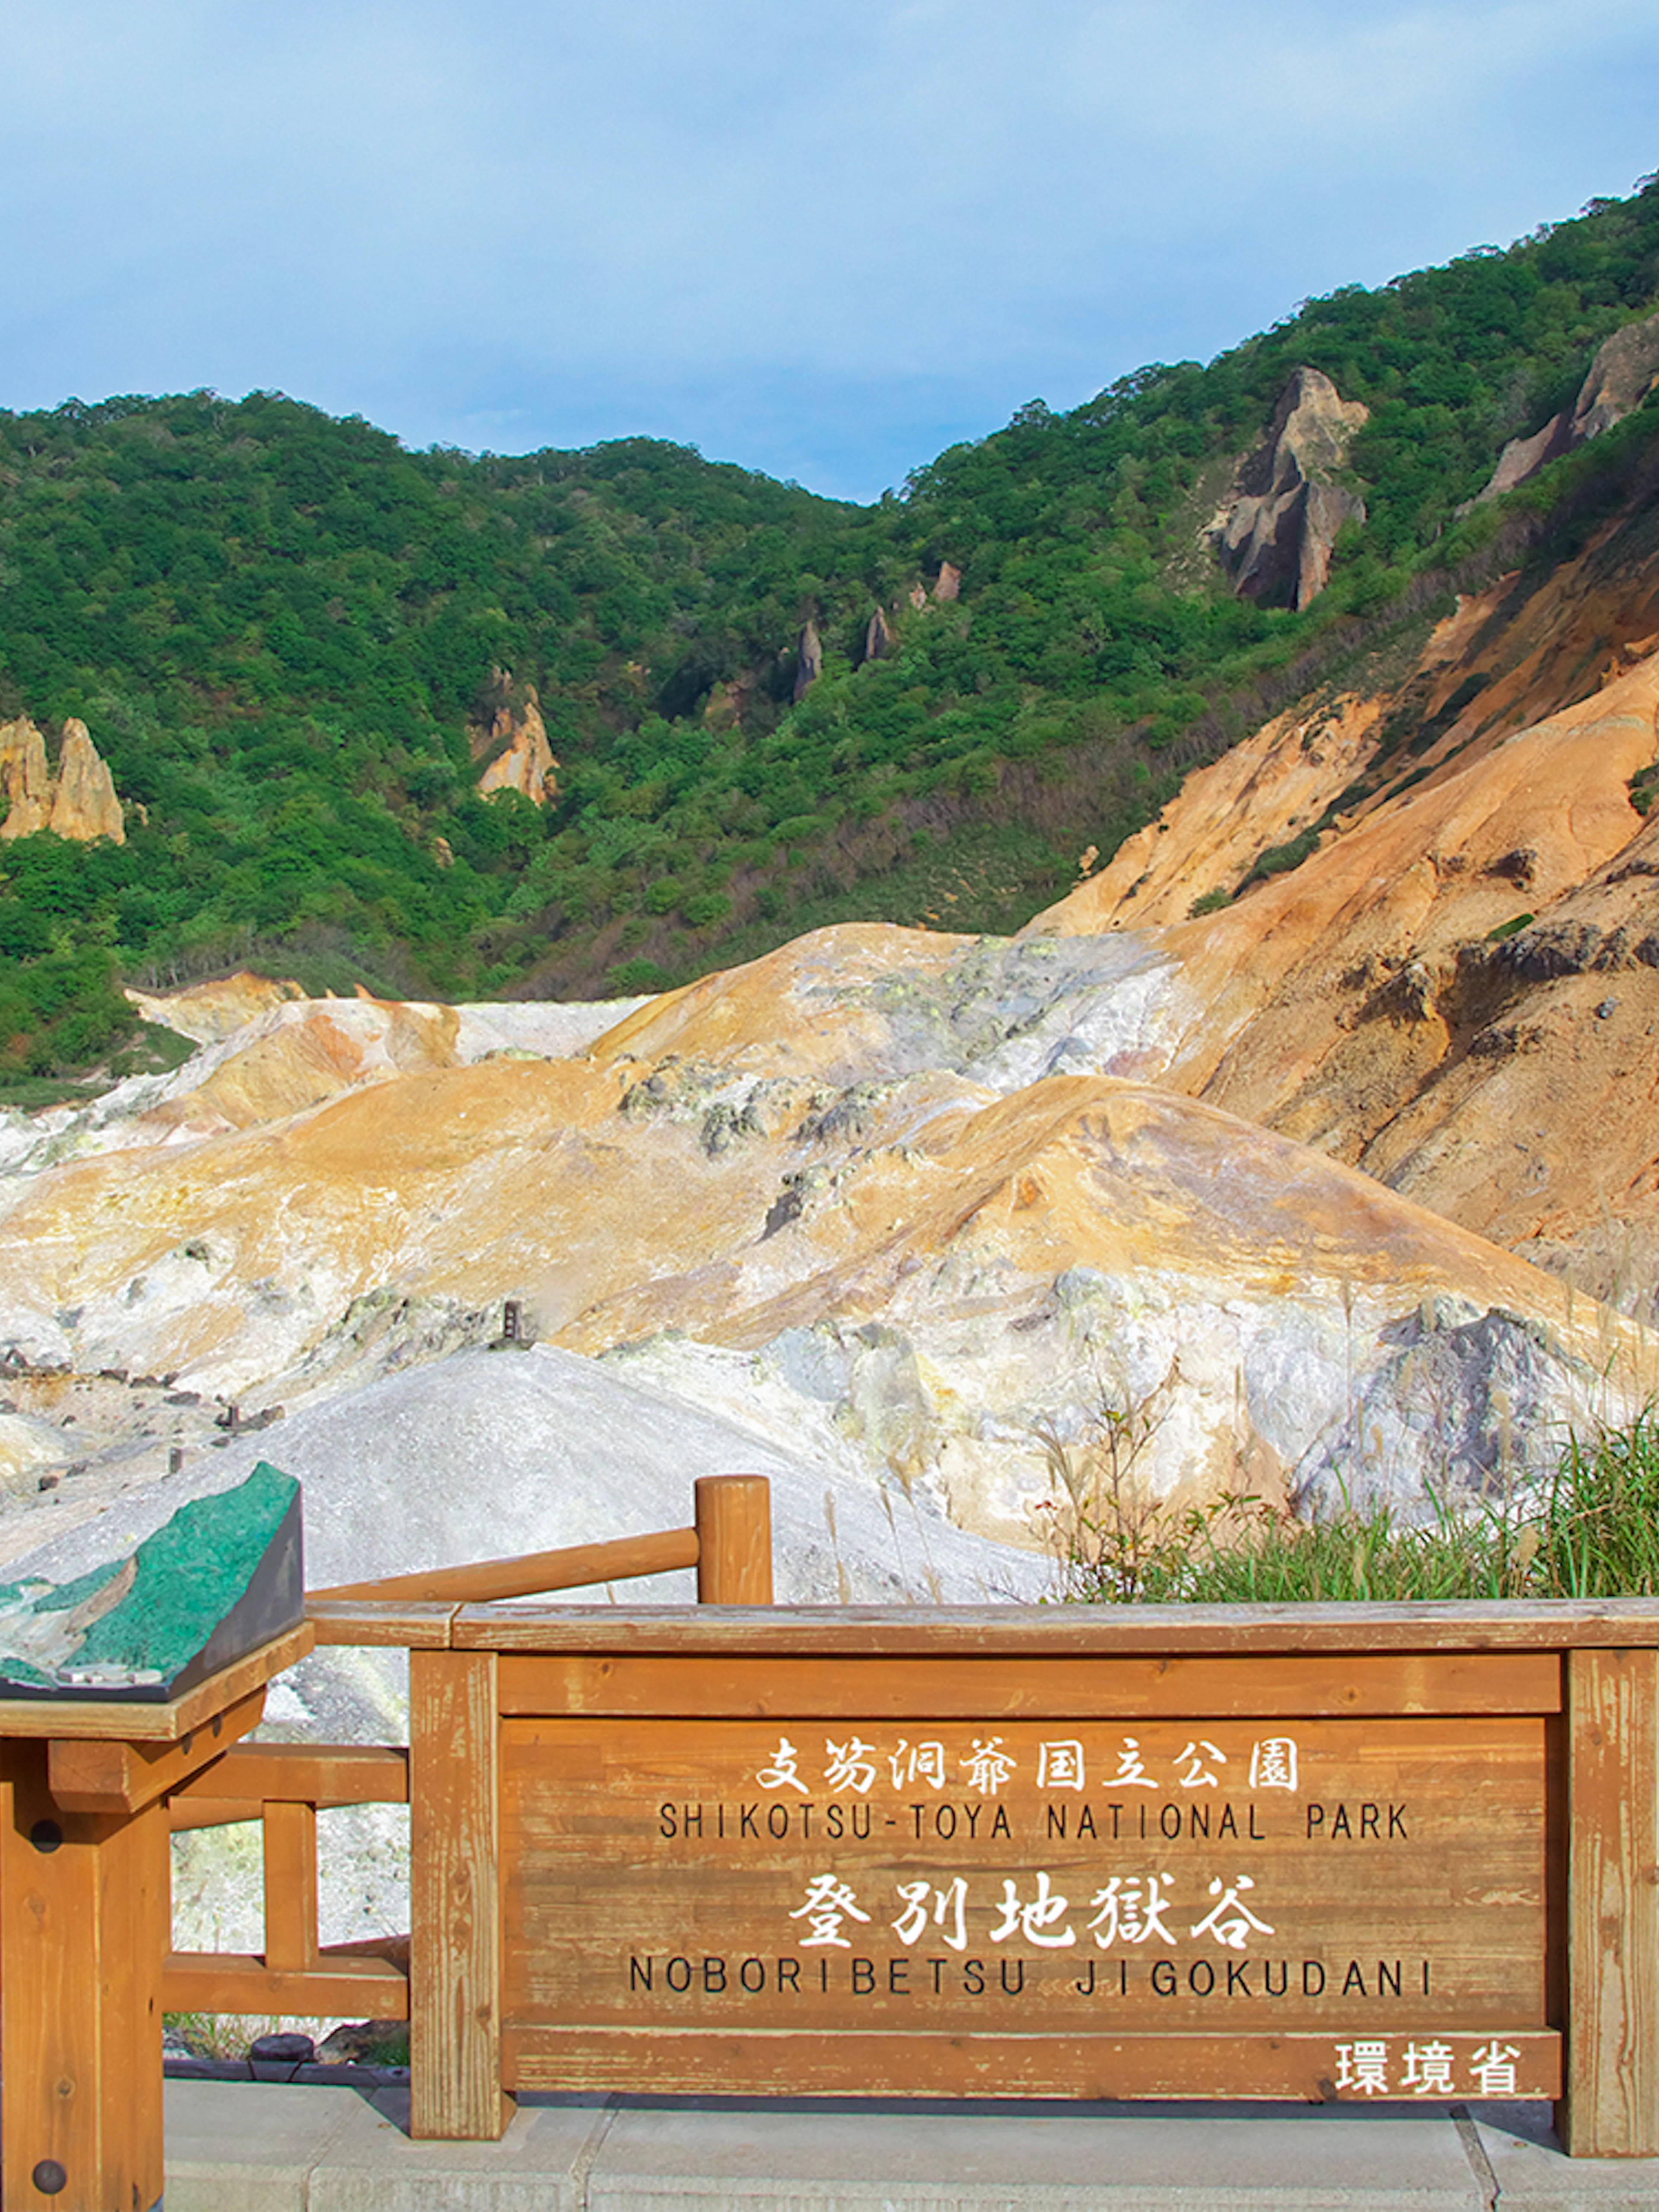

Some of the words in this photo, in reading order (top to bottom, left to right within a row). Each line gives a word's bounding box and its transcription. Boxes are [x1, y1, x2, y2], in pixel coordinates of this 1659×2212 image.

[755, 1736, 1298, 1795] 支笏洞爺国立公園
[659, 1803, 1011, 1840] SHIKOTSU-TOYA
[1047, 1803, 1266, 1840] NATIONAL
[1306, 1803, 1409, 1840] PARK
[788, 1871, 1276, 1951] 登別地獄谷
[629, 1957, 1024, 1996] NOBORIBETSU
[1076, 1959, 1430, 1998] JIGOKUDANI
[1334, 2040, 1521, 2096] 環境省
